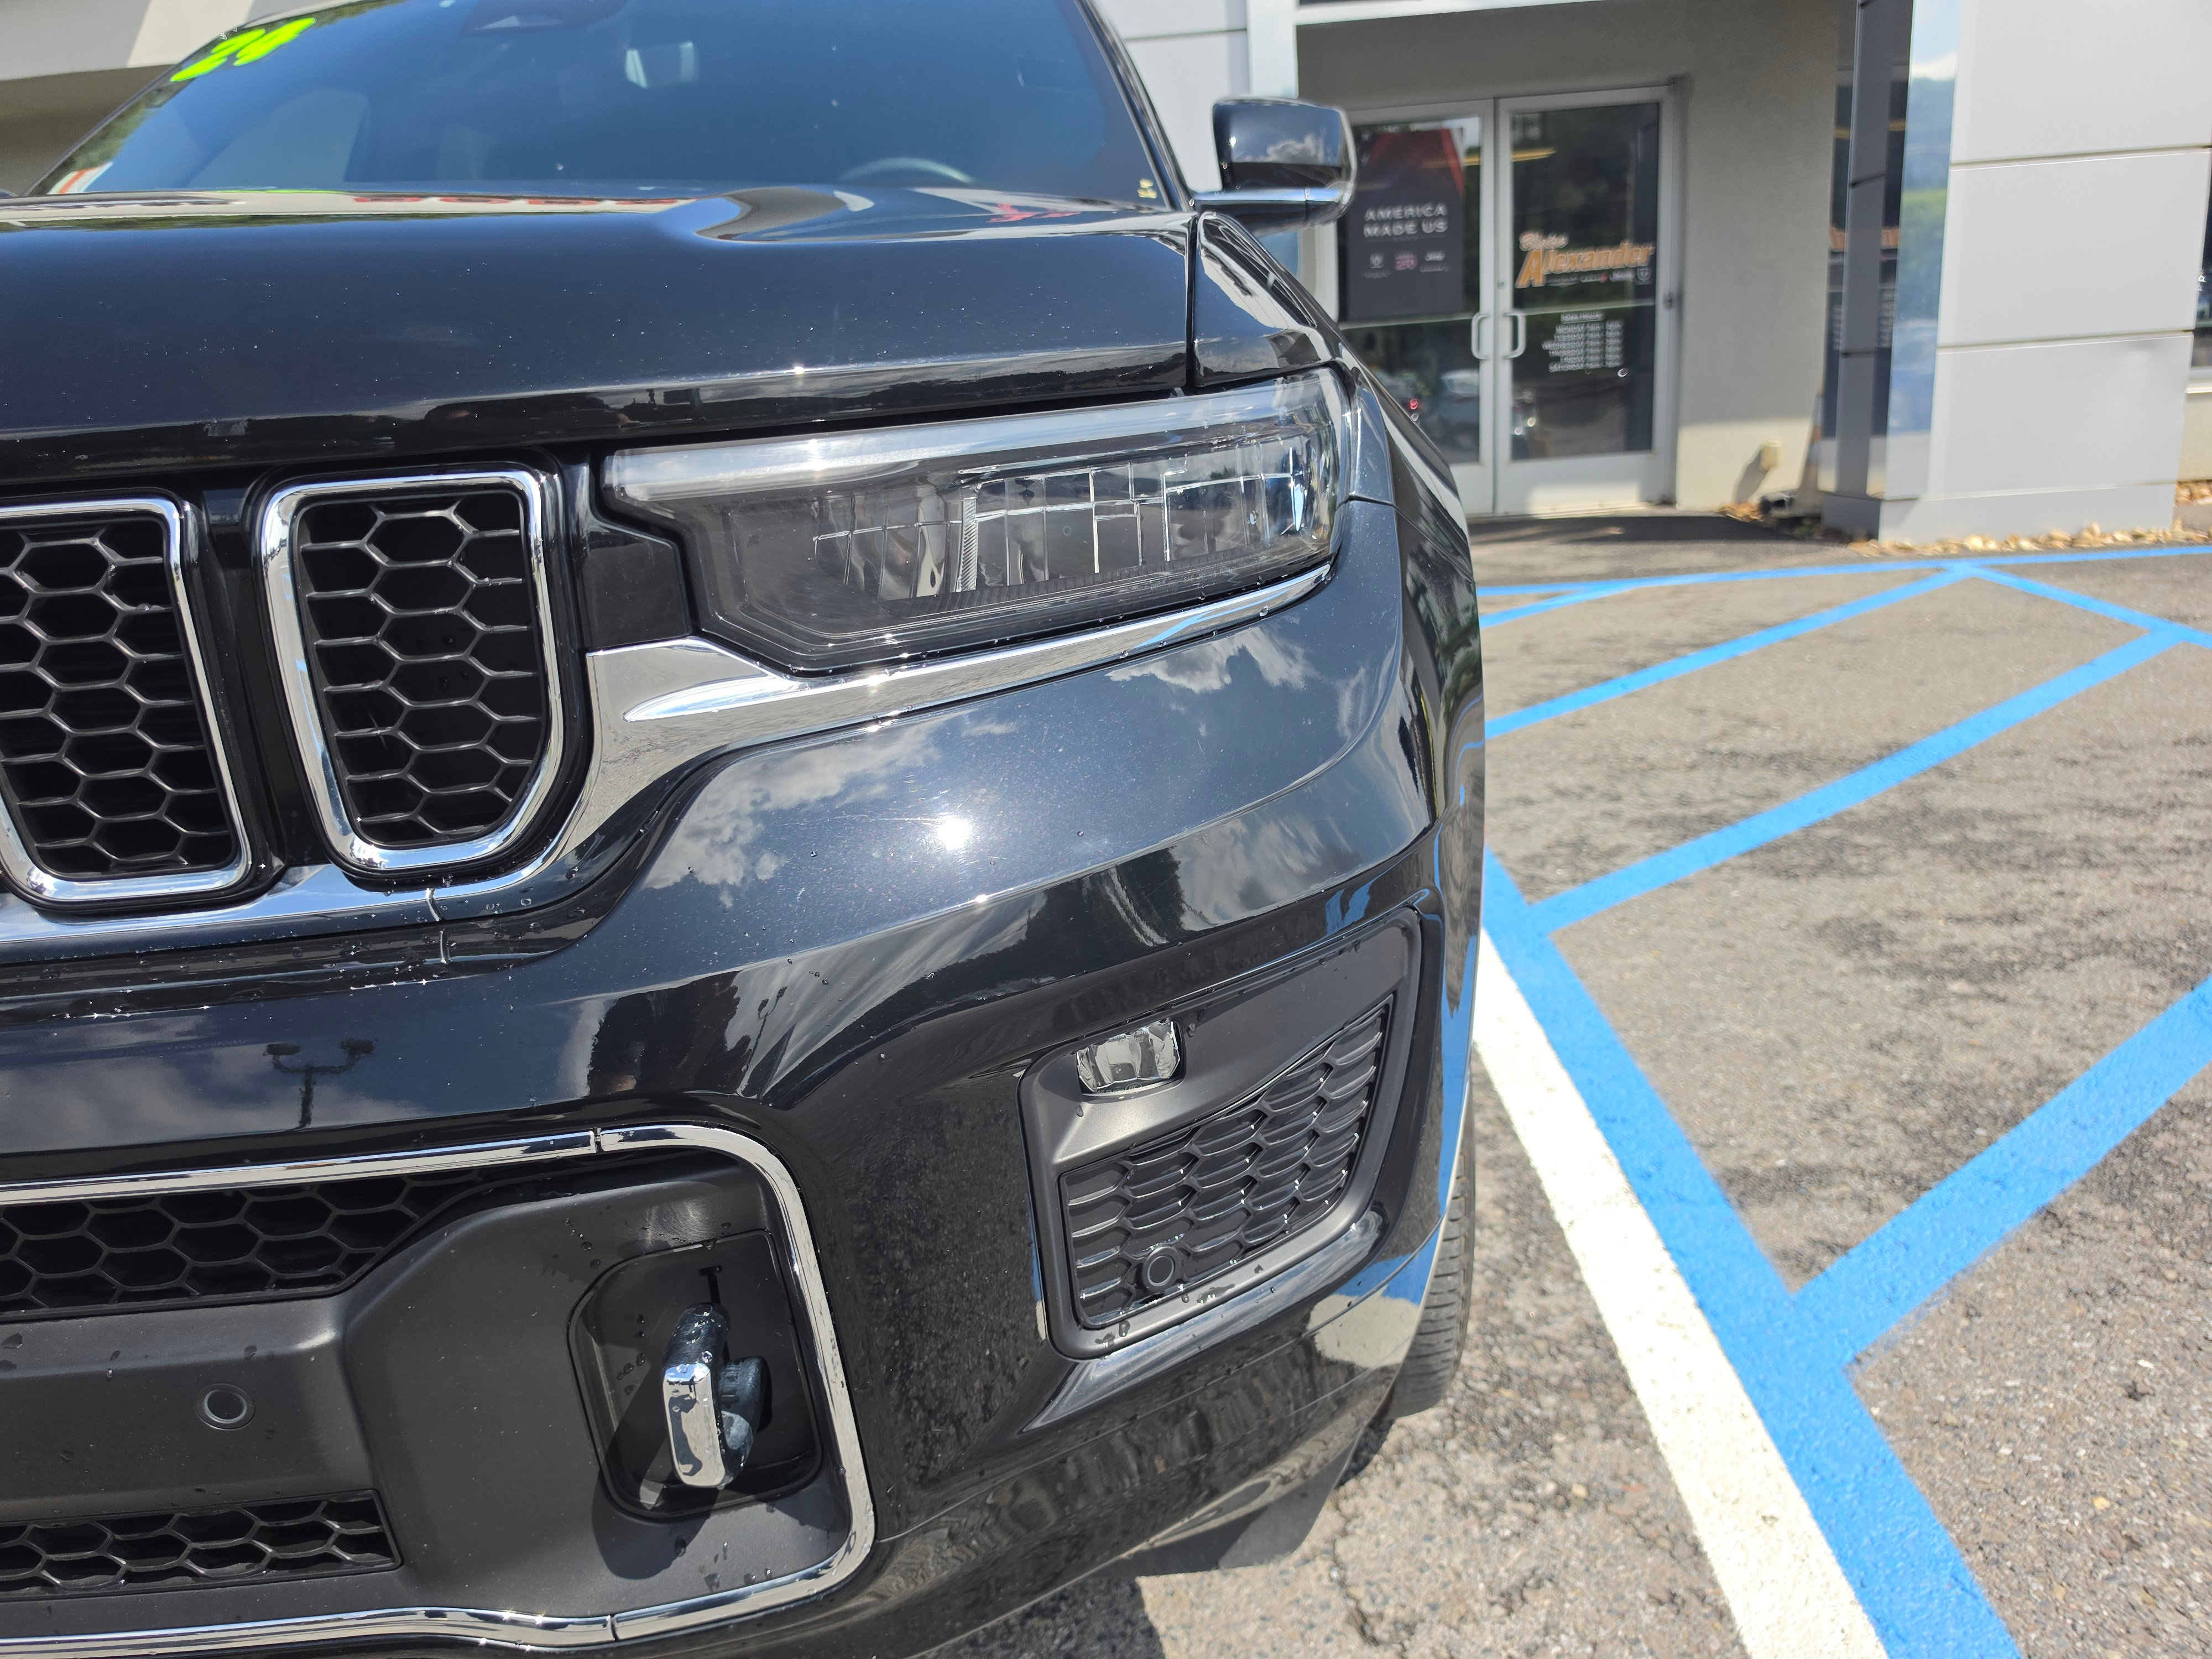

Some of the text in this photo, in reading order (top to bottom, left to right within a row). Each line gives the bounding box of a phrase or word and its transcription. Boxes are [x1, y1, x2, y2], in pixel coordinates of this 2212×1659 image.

[1364, 203, 1448, 222] AMERICA
[1363, 217, 1448, 237] MADE US
[1515, 239, 1656, 289] Alexander
